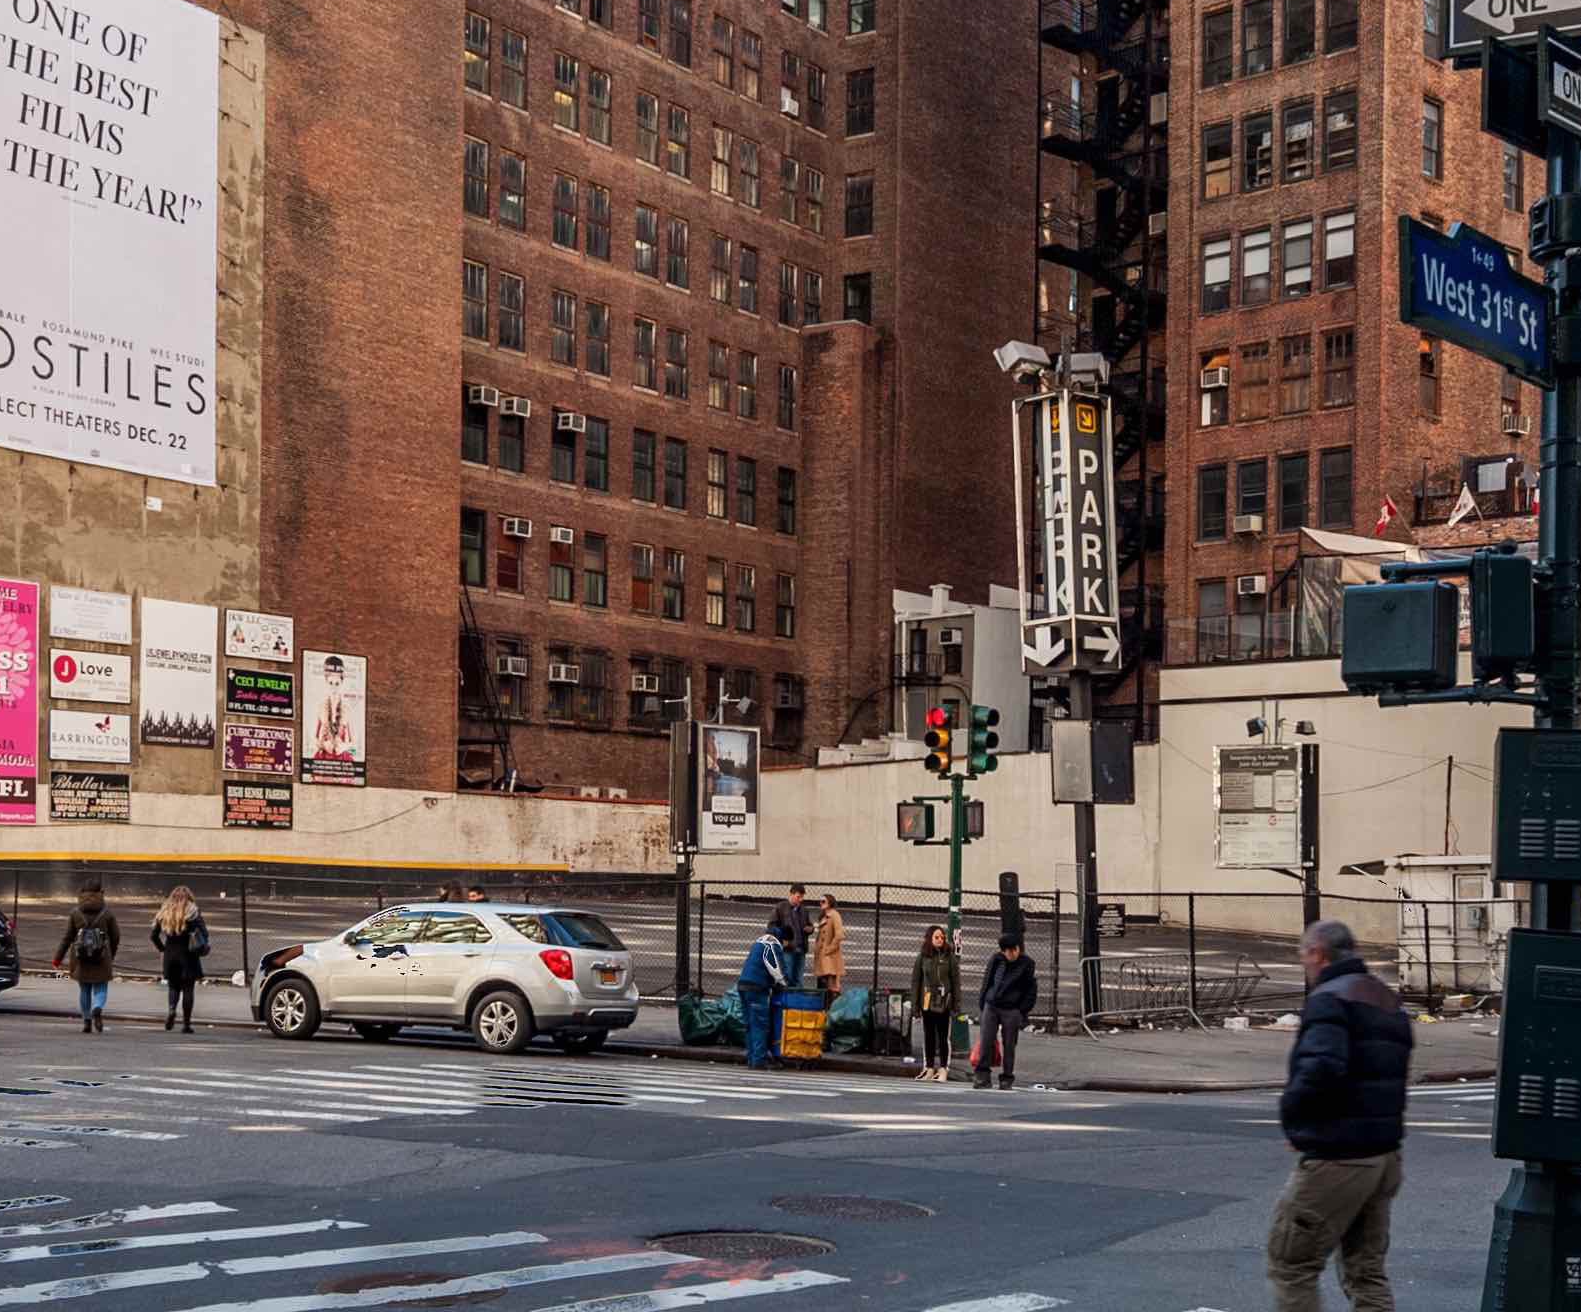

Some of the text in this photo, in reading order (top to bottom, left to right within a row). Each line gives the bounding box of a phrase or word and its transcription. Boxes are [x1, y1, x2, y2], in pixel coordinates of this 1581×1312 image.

[102, 24, 148, 63] OF
[73, 62, 158, 117] BEST
[19, 92, 124, 156] FILMS
[4, 138, 79, 192] THE
[1422, 252, 1538, 351] West 31st St
[42, 319, 105, 343] ROSAMUND
[110, 337, 133, 351] PIKE
[150, 348, 171, 359] WES
[175, 353, 205, 368] STUDI
[44, 406, 122, 436] THEATERS
[128, 424, 162, 446] DEC.
[168, 433, 188, 451] 22
[1078, 448, 1106, 614] PARK
[80, 661, 113, 677] Love
[257, 678, 290, 691] JEWELRY
[51, 731, 128, 747] BARRINGTON
[242, 738, 276, 749] JEWELRY
[714, 815, 744, 823] YOU CAN
